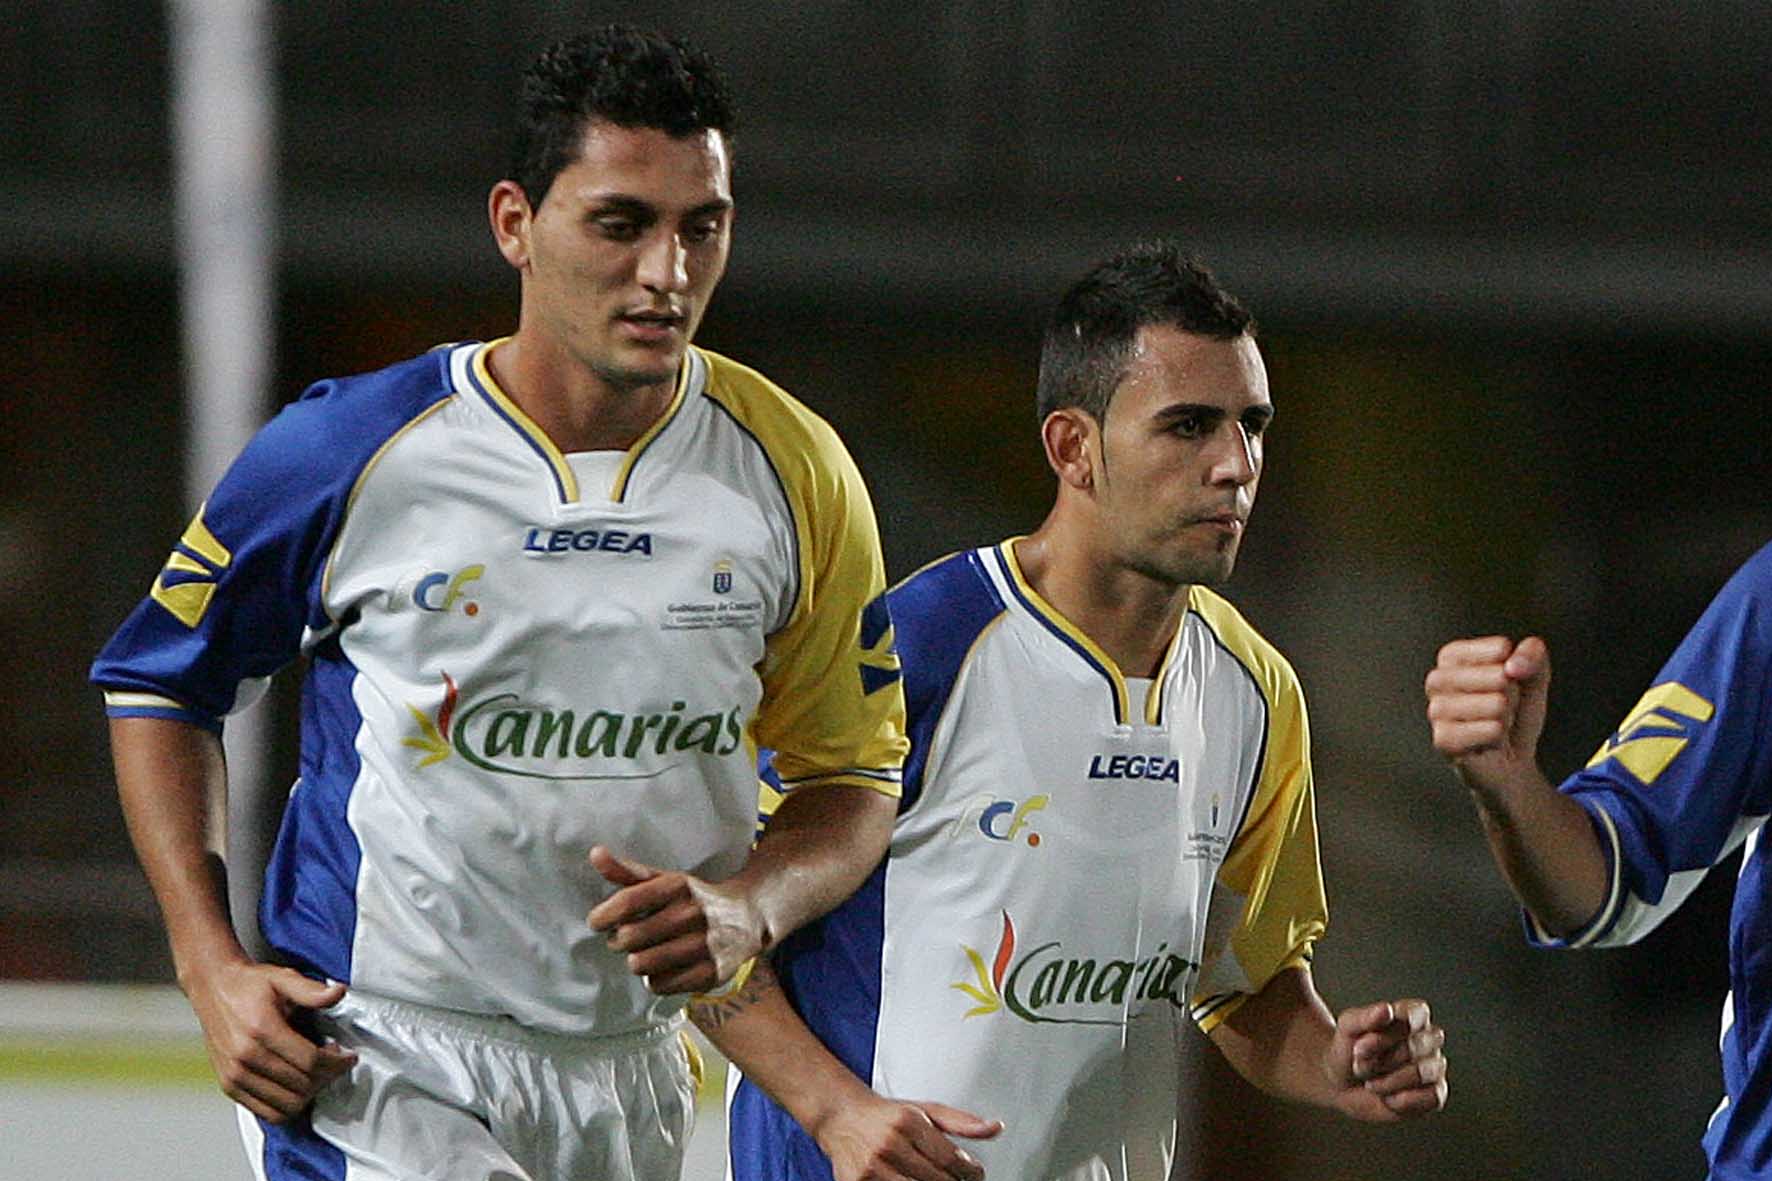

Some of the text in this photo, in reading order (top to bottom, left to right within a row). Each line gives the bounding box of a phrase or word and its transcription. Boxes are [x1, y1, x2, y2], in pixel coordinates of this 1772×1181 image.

[524, 528, 652, 555] LEGEA
[451, 692, 742, 780] Canarias
[1088, 755, 1181, 783] LEGEA
